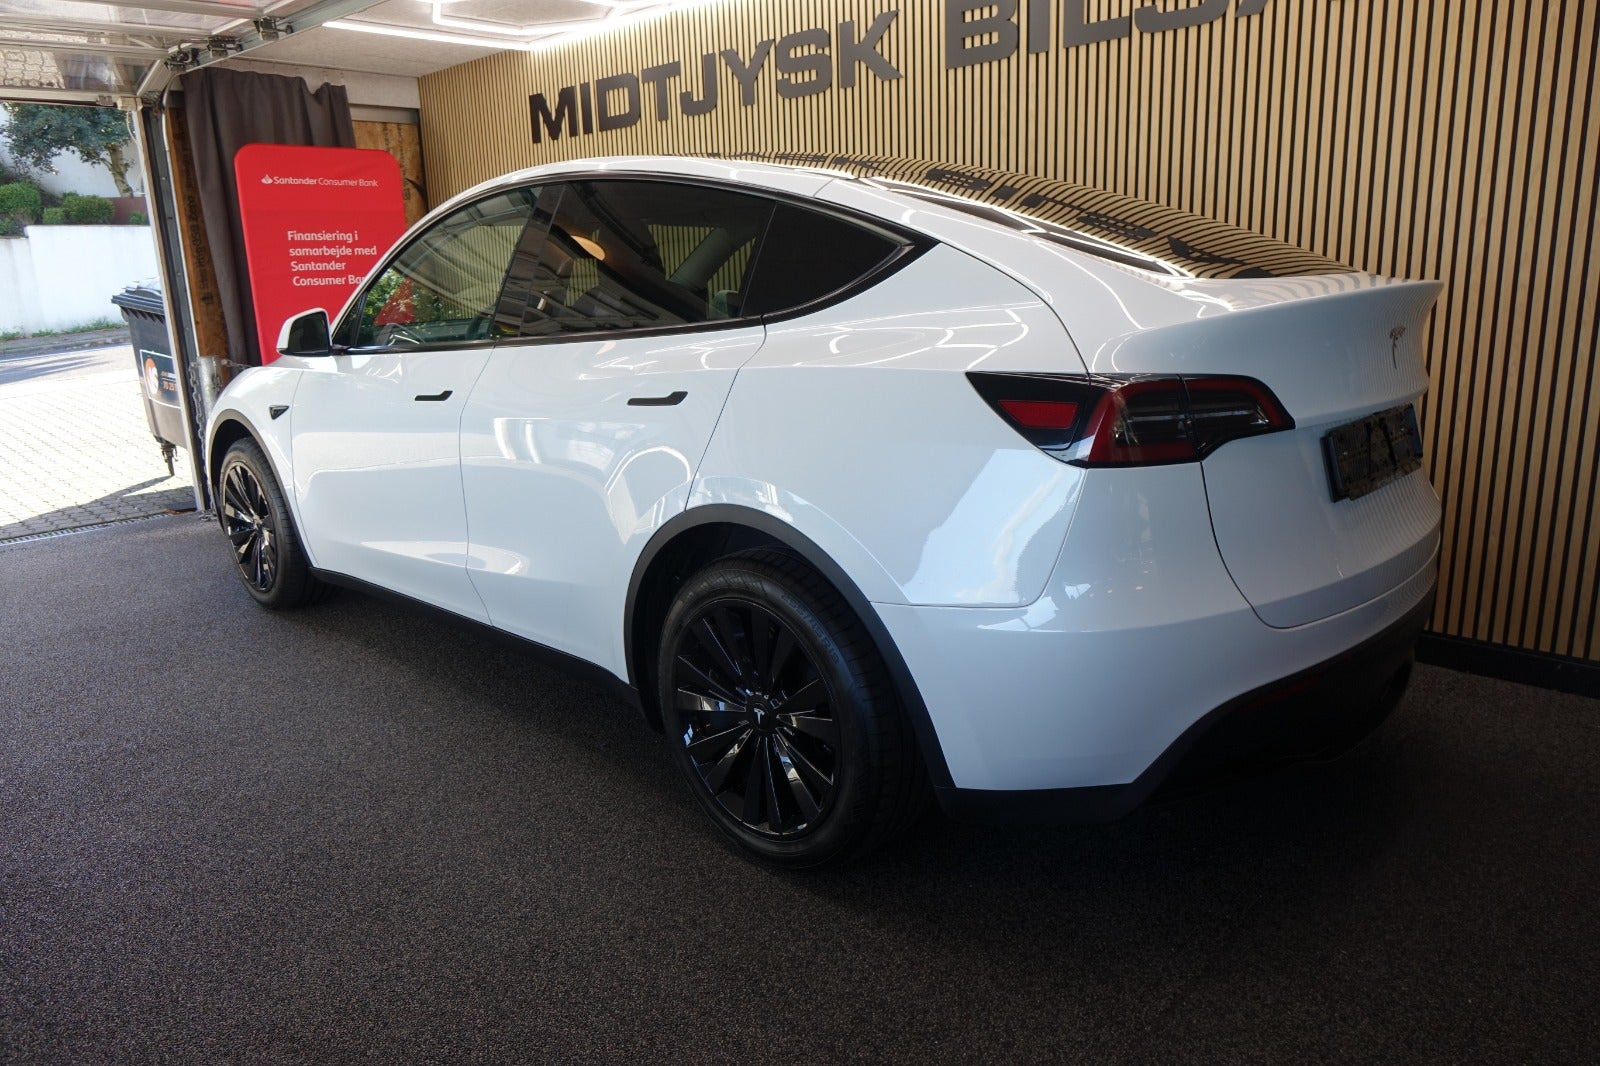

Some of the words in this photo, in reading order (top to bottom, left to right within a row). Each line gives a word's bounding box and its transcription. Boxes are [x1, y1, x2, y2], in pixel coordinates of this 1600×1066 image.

[528, 8, 904, 145] MIDTJYSK
[273, 176, 317, 185] Santander
[318, 177, 358, 187] Consumer
[359, 178, 379, 187] Bank
[287, 230, 353, 243] Finansiering
[354, 230, 359, 241] i
[289, 245, 352, 258] samarbejde
[354, 245, 377, 256] med
[290, 260, 347, 272] Santander
[292, 276, 347, 286] Consumer
[347, 274, 366, 285] Ba
